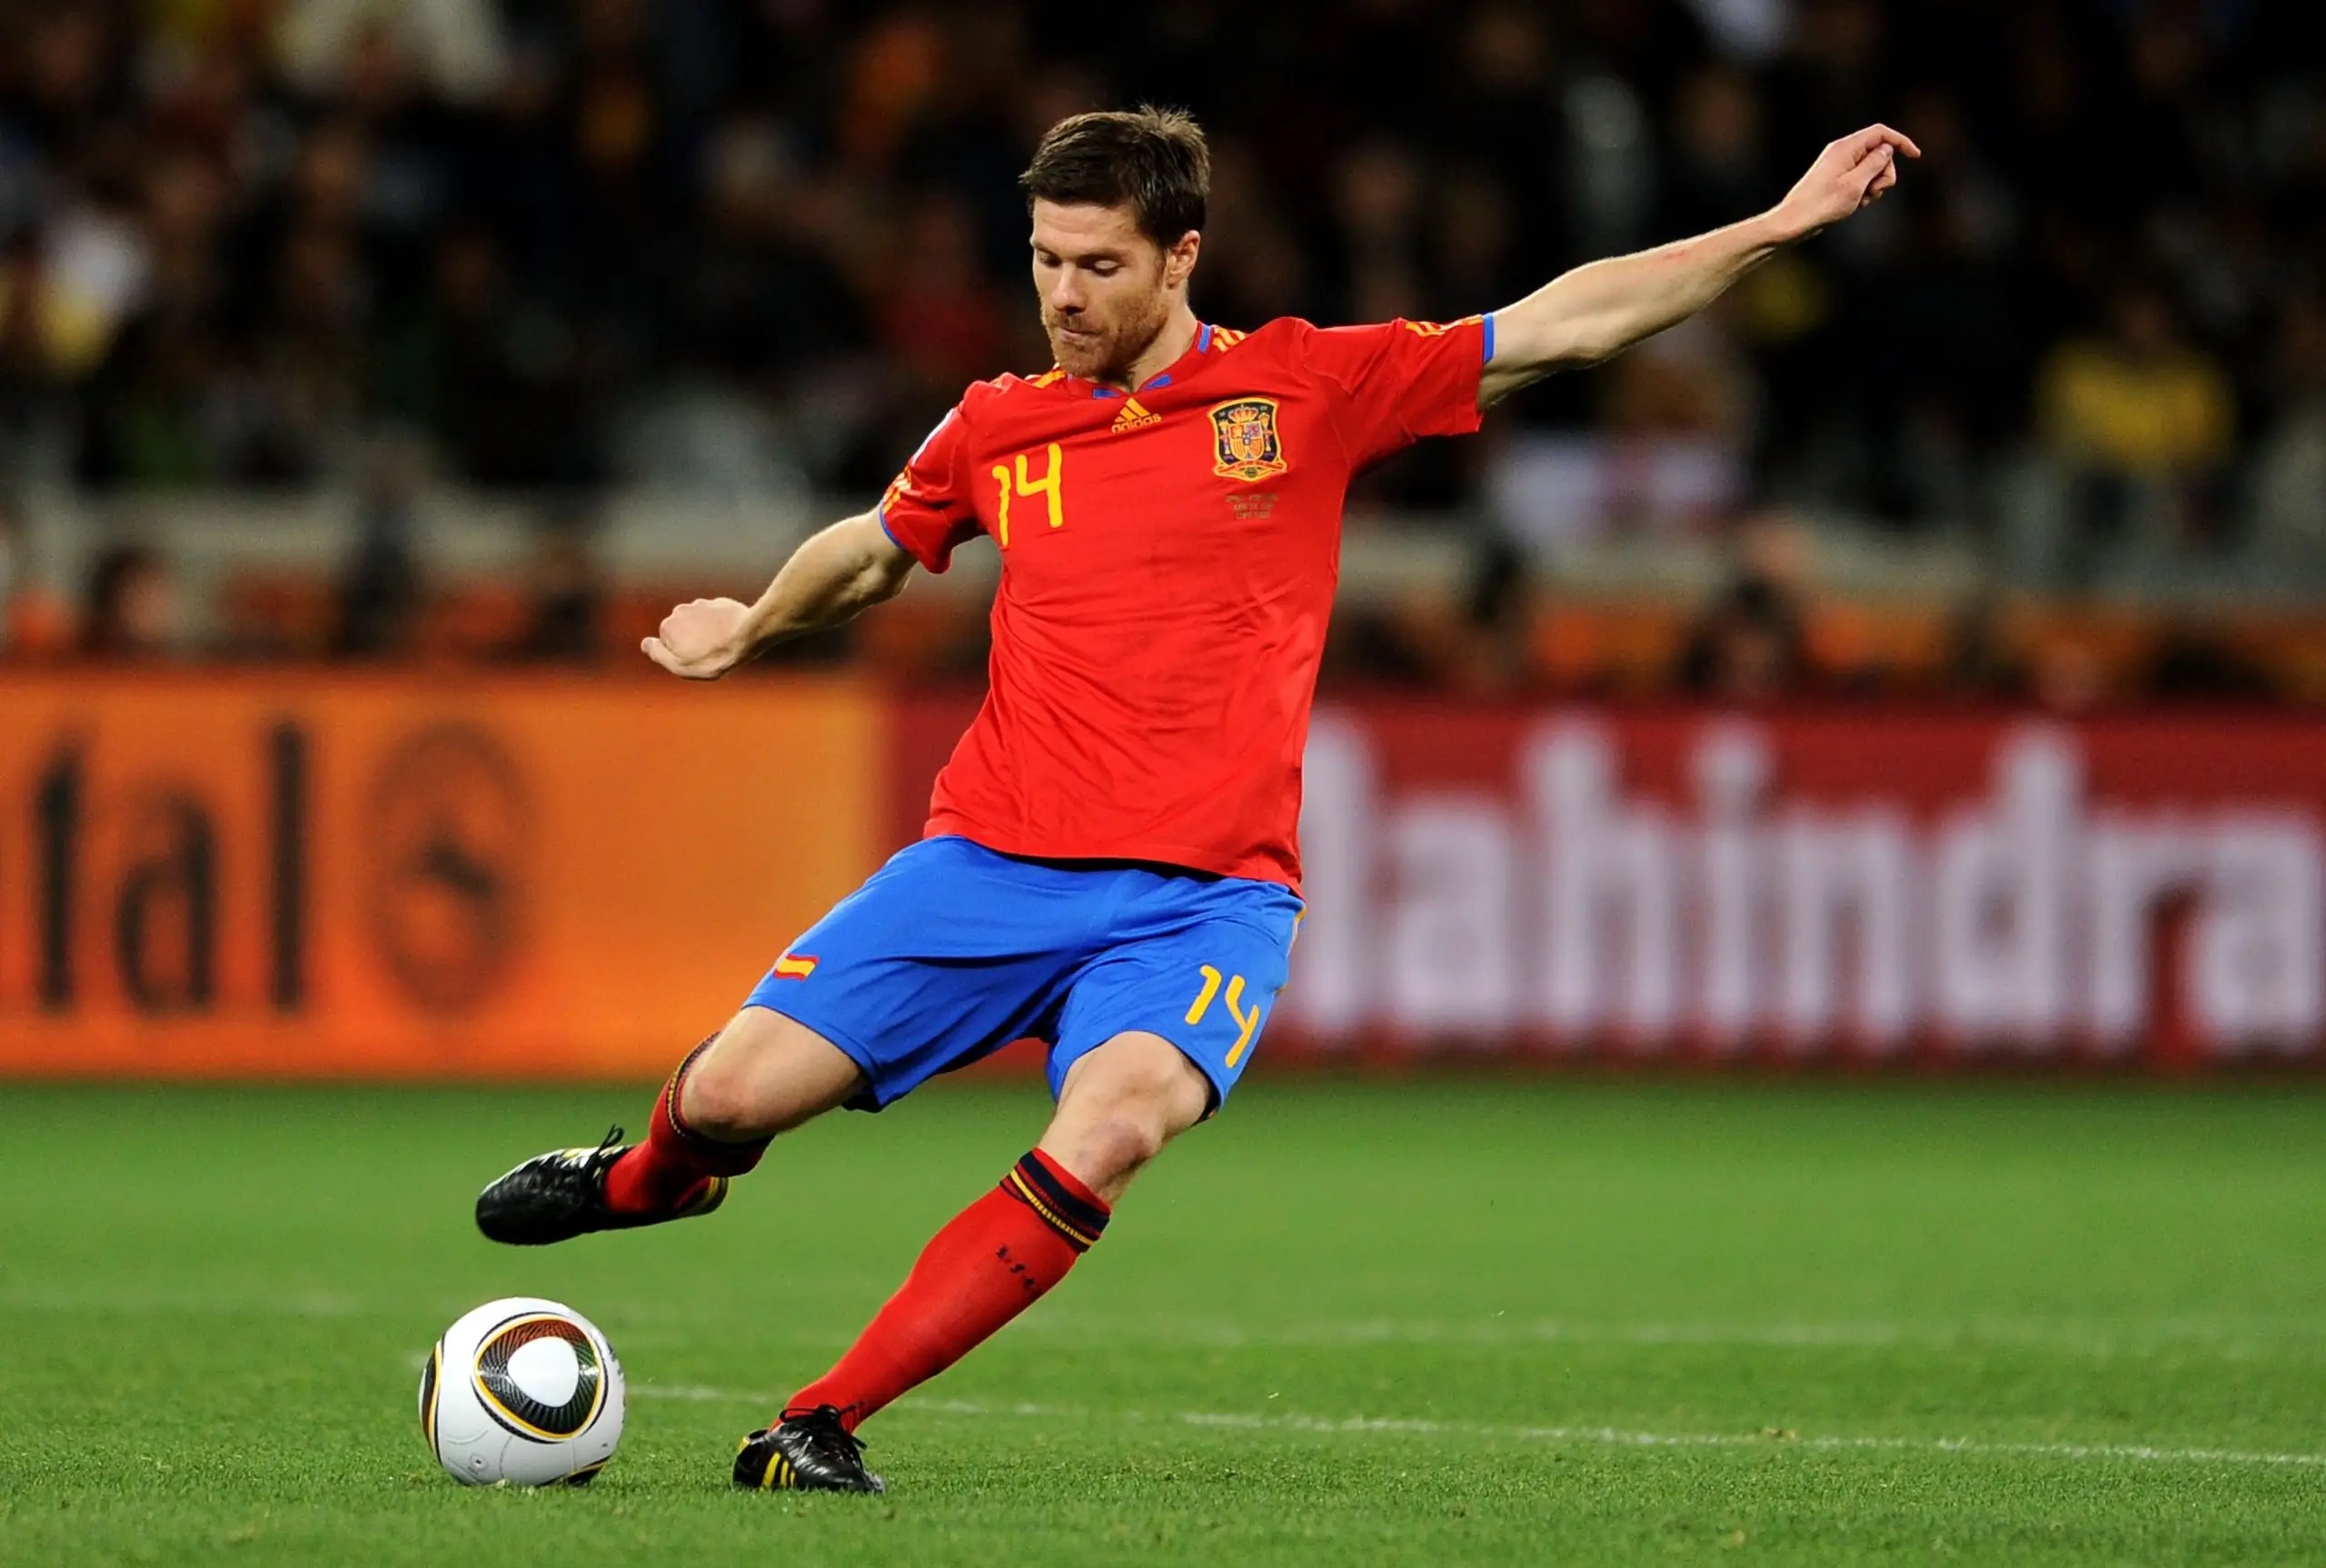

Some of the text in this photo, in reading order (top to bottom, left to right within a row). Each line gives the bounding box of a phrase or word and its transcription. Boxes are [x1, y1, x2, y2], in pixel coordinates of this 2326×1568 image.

[1111, 413, 1162, 433] adidas
[991, 442, 1062, 545] 14
[1185, 965, 1259, 1068] 14
